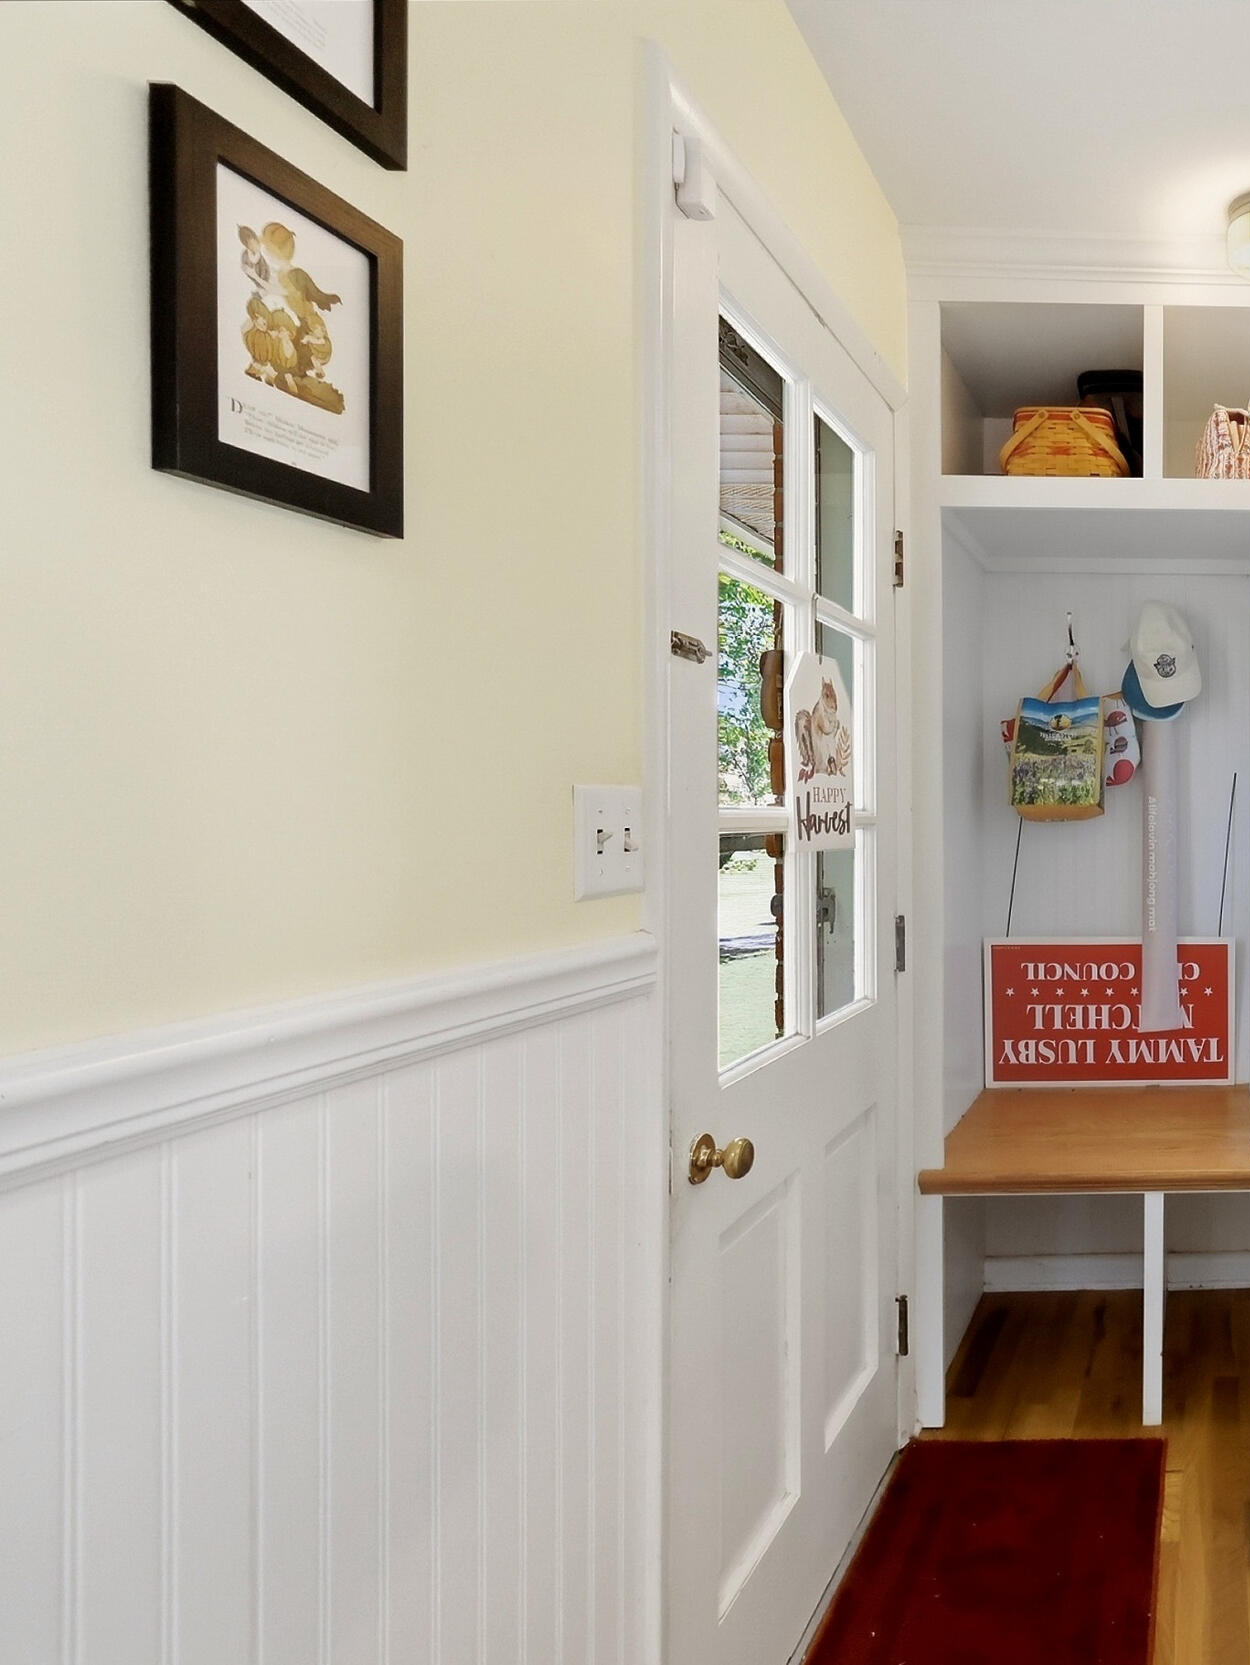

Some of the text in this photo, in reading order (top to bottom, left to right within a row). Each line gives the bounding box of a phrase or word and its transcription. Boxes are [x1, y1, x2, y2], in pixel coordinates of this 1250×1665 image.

[813, 786, 847, 803] HAPPY
[796, 791, 853, 841] Harvest
[1146, 851, 1157, 905] mahjong
[1020, 962, 1136, 981] COUNCIL
[1026, 1003, 1194, 1030] MCHELL
[998, 1037, 1224, 1065] TAMMY LUSBY
